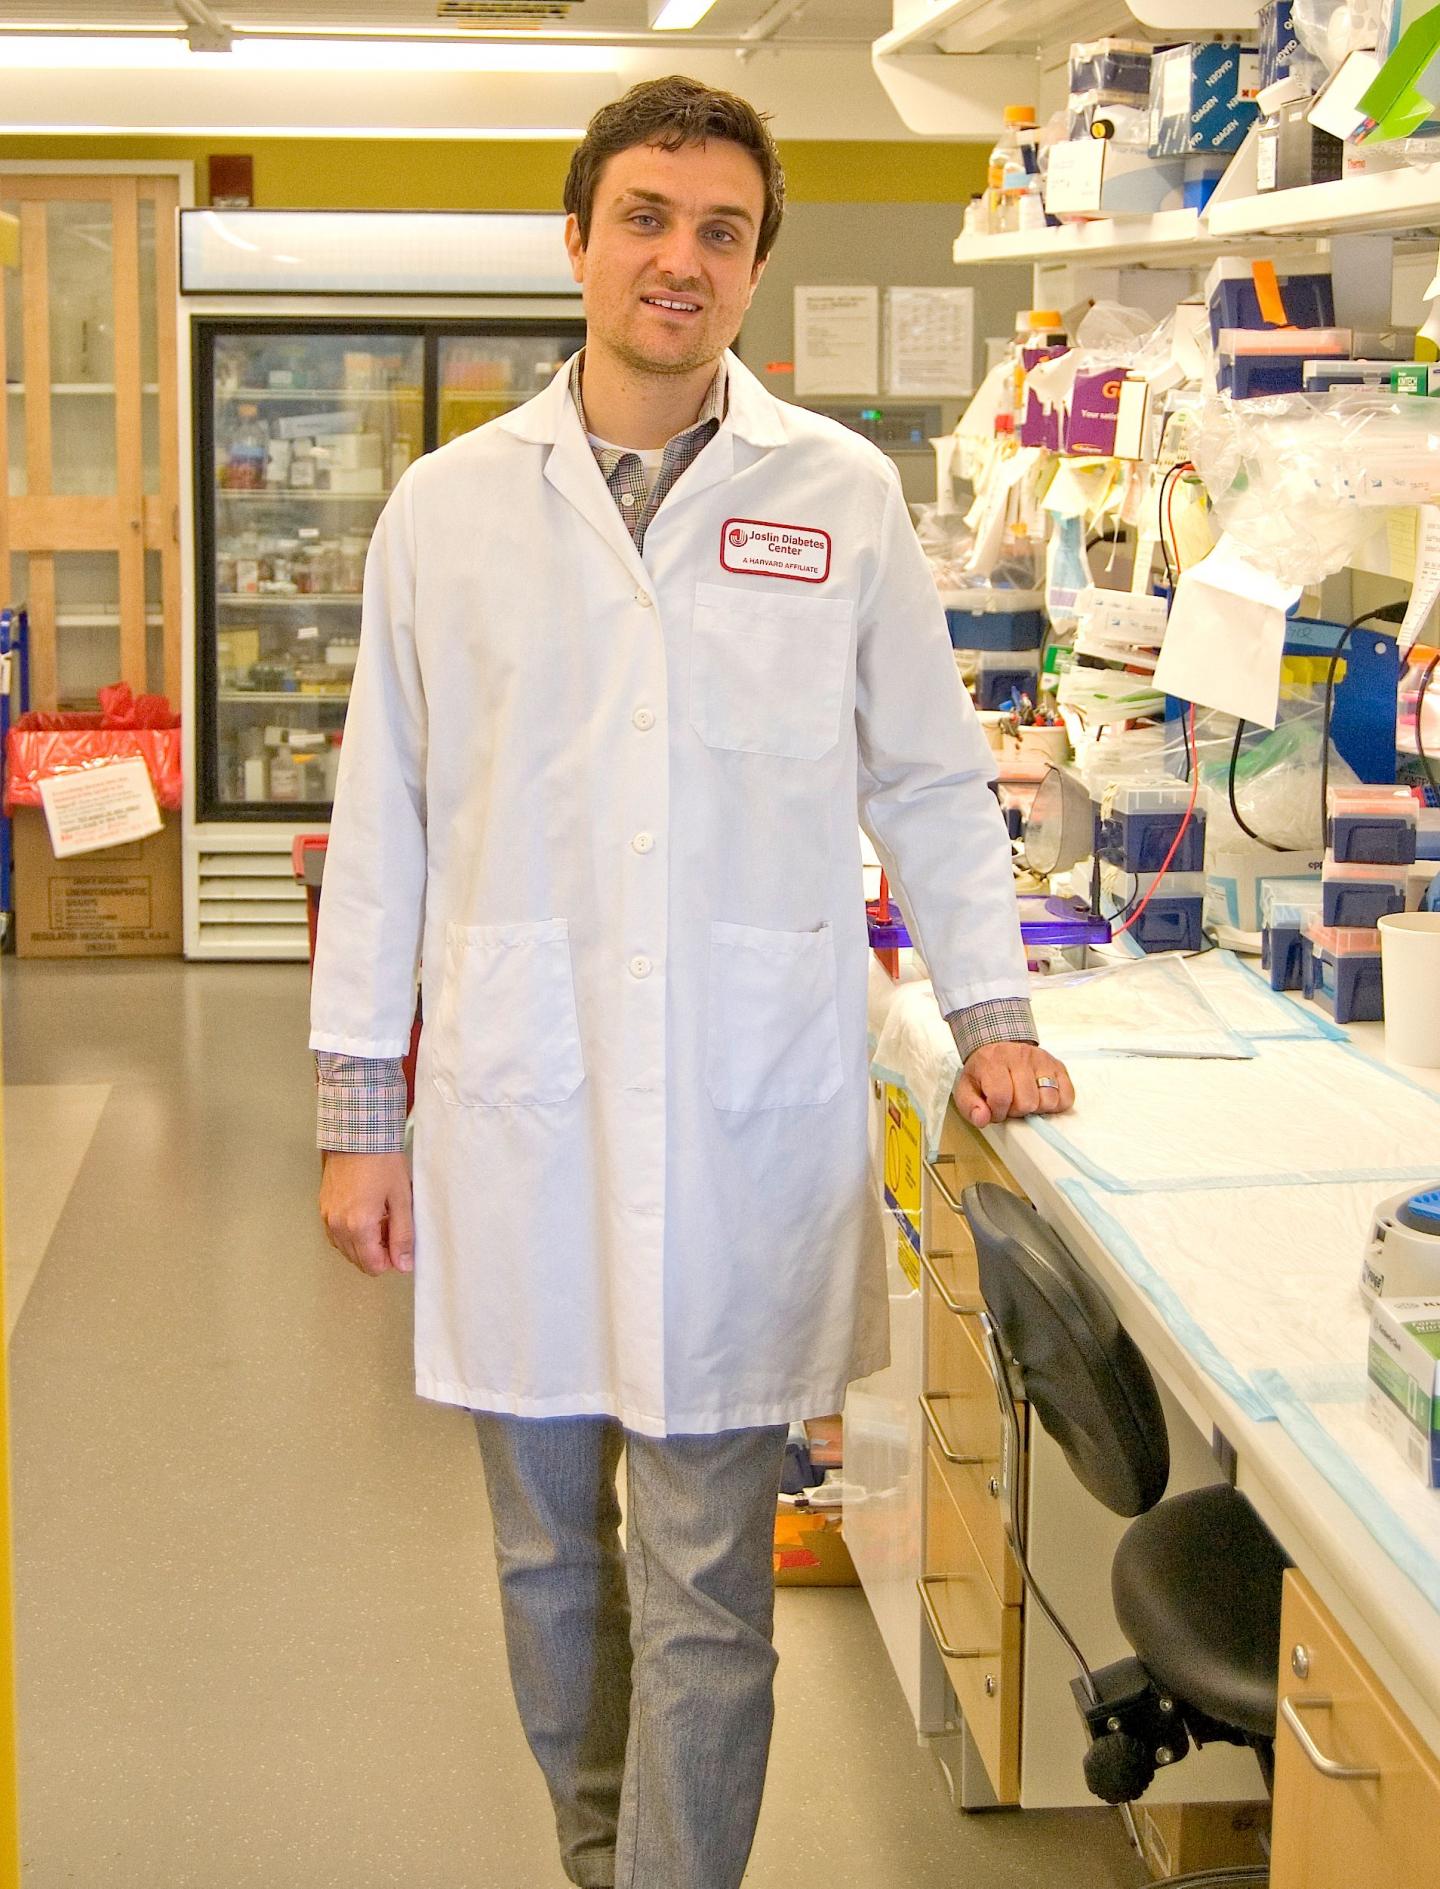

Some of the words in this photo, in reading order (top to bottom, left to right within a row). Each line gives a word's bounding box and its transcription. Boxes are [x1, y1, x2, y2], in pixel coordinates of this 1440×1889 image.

[1205, 60, 1233, 87] QIAGEN
[1191, 95, 1218, 123] QIAGEN
[1212, 119, 1239, 146] QIAGEN
[750, 531, 779, 543] Joslin
[781, 535, 825, 550] Diabetes
[768, 543, 802, 556] Center
[749, 558, 783, 568] HARVARD
[785, 562, 818, 574] AFFILIATE
